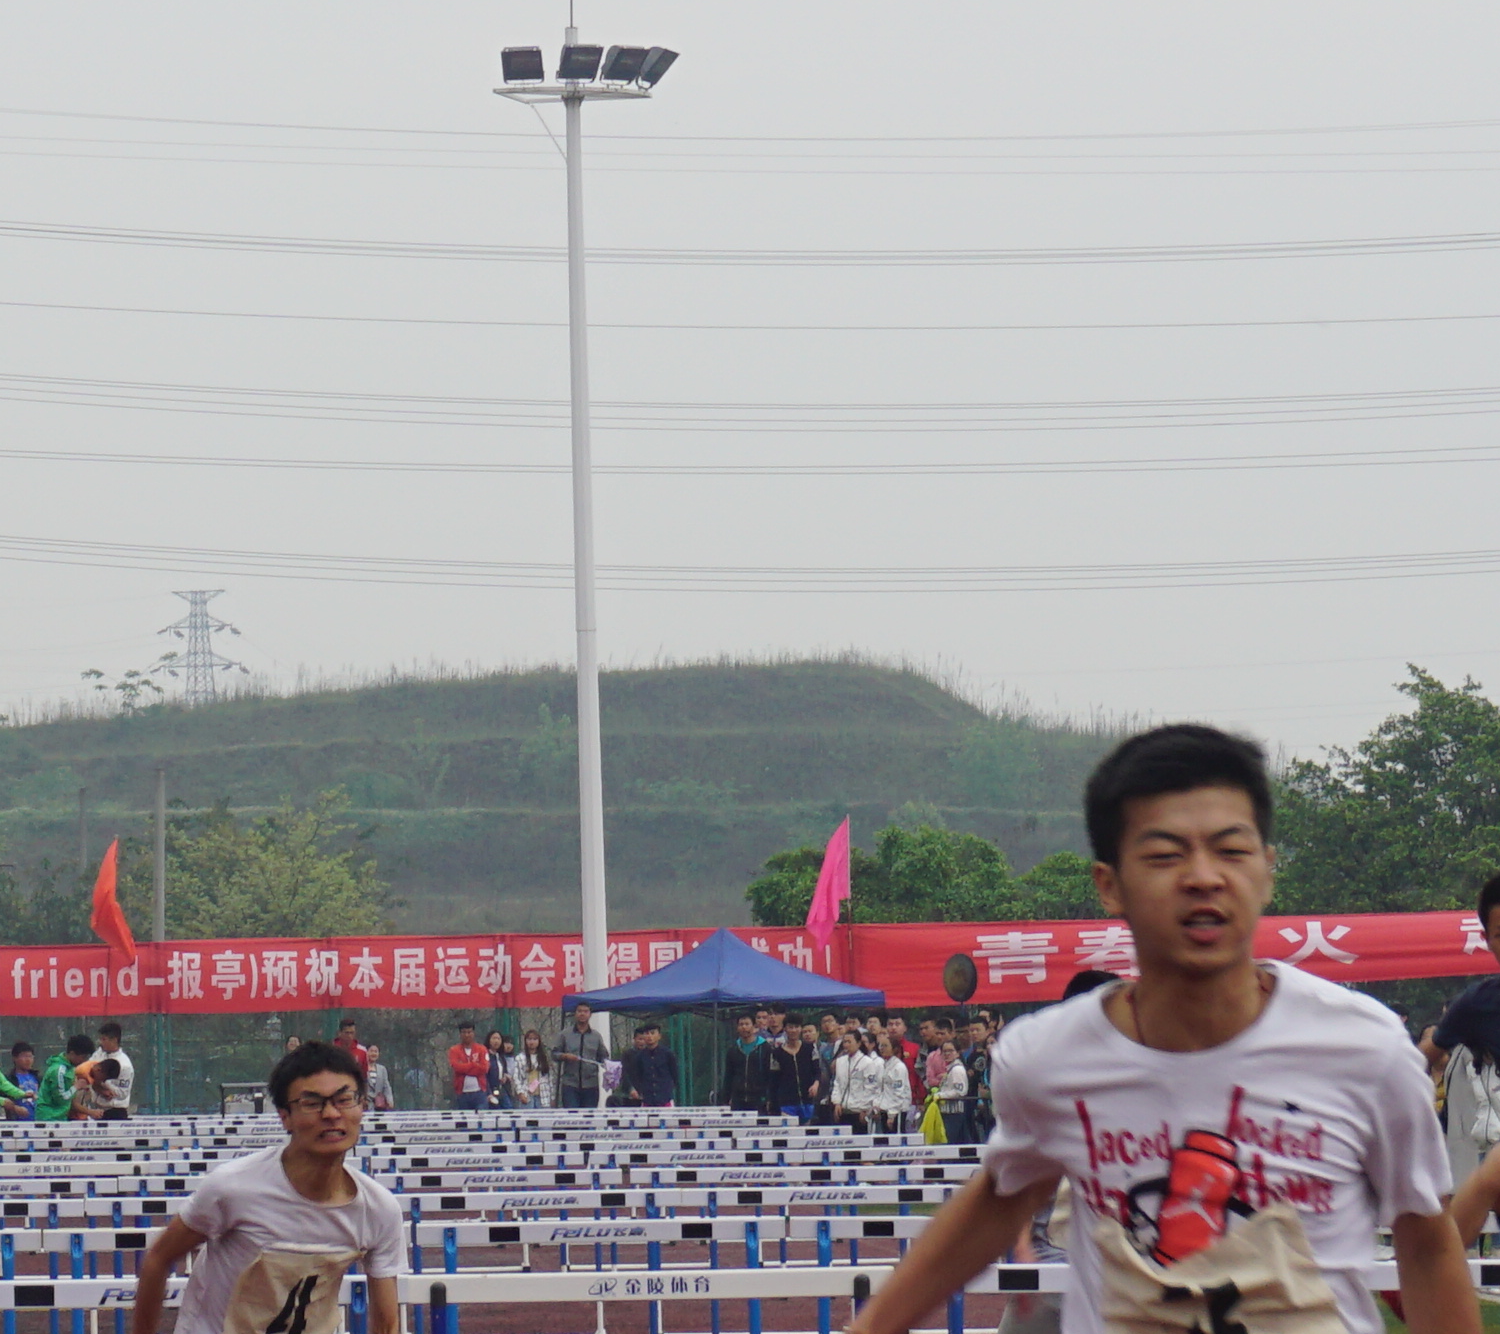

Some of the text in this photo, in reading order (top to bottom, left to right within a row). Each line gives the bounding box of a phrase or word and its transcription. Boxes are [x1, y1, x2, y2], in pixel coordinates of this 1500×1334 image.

[973, 921, 1358, 984] 青春火
[625, 1276, 709, 1295] 金陵体育
